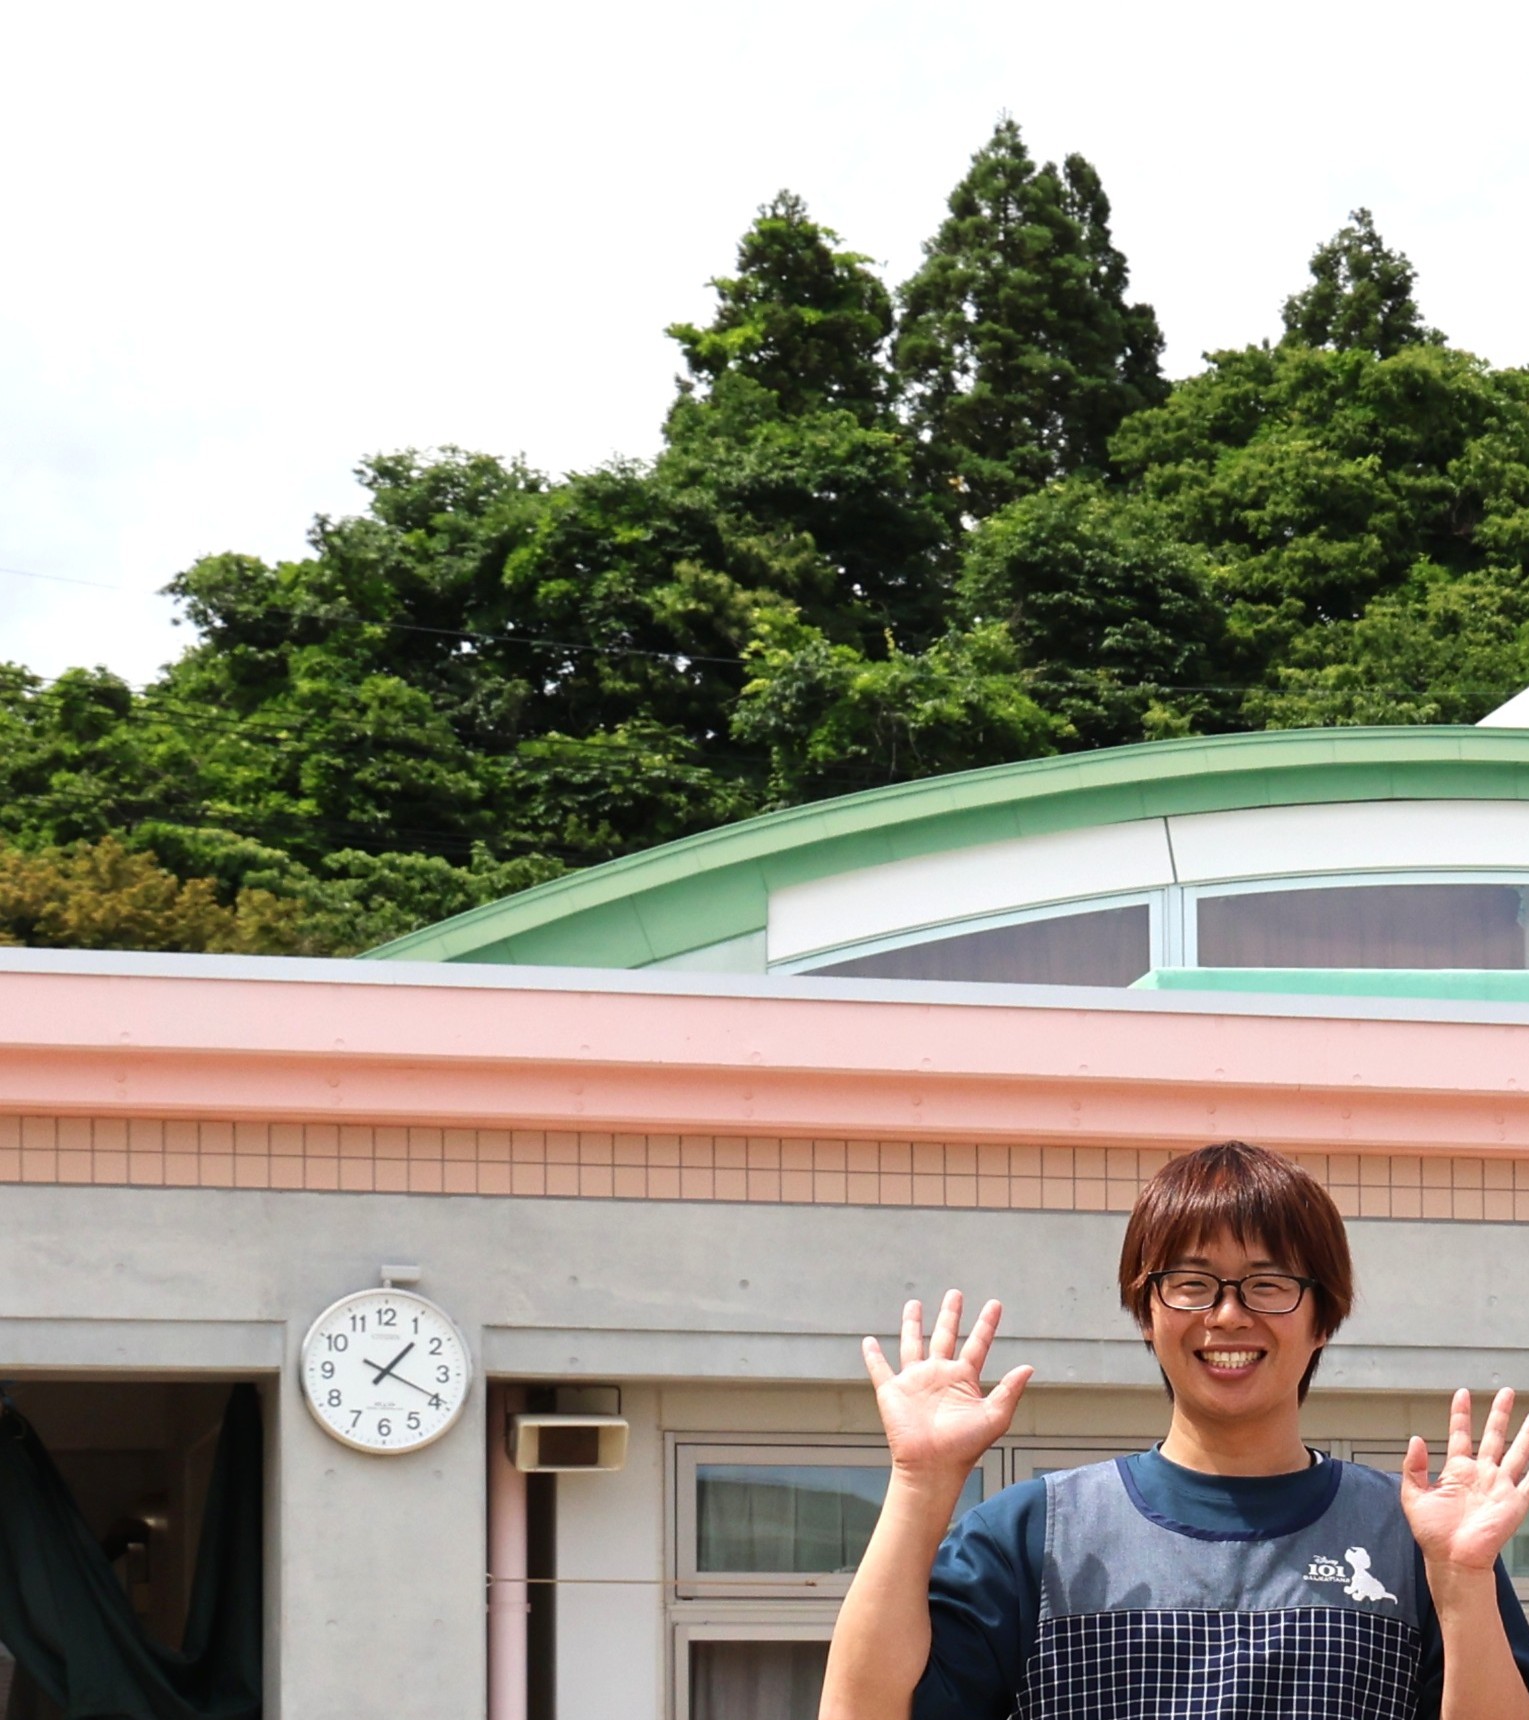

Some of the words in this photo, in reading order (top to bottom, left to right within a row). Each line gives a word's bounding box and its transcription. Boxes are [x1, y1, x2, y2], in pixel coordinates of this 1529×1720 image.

[350, 1314, 366, 1332] 11
[376, 1308, 397, 1326] 12
[412, 1317, 418, 1335] 1
[326, 1334, 348, 1352] 10
[429, 1337, 442, 1355] 2
[321, 1361, 335, 1379] 9
[436, 1365, 449, 1383] 3
[327, 1389, 341, 1407] 8
[428, 1393, 442, 1410] 4
[349, 1410, 362, 1428] 7
[377, 1419, 391, 1437] 6
[407, 1412, 420, 1430] 5
[1308, 1564, 1346, 1577] 101
